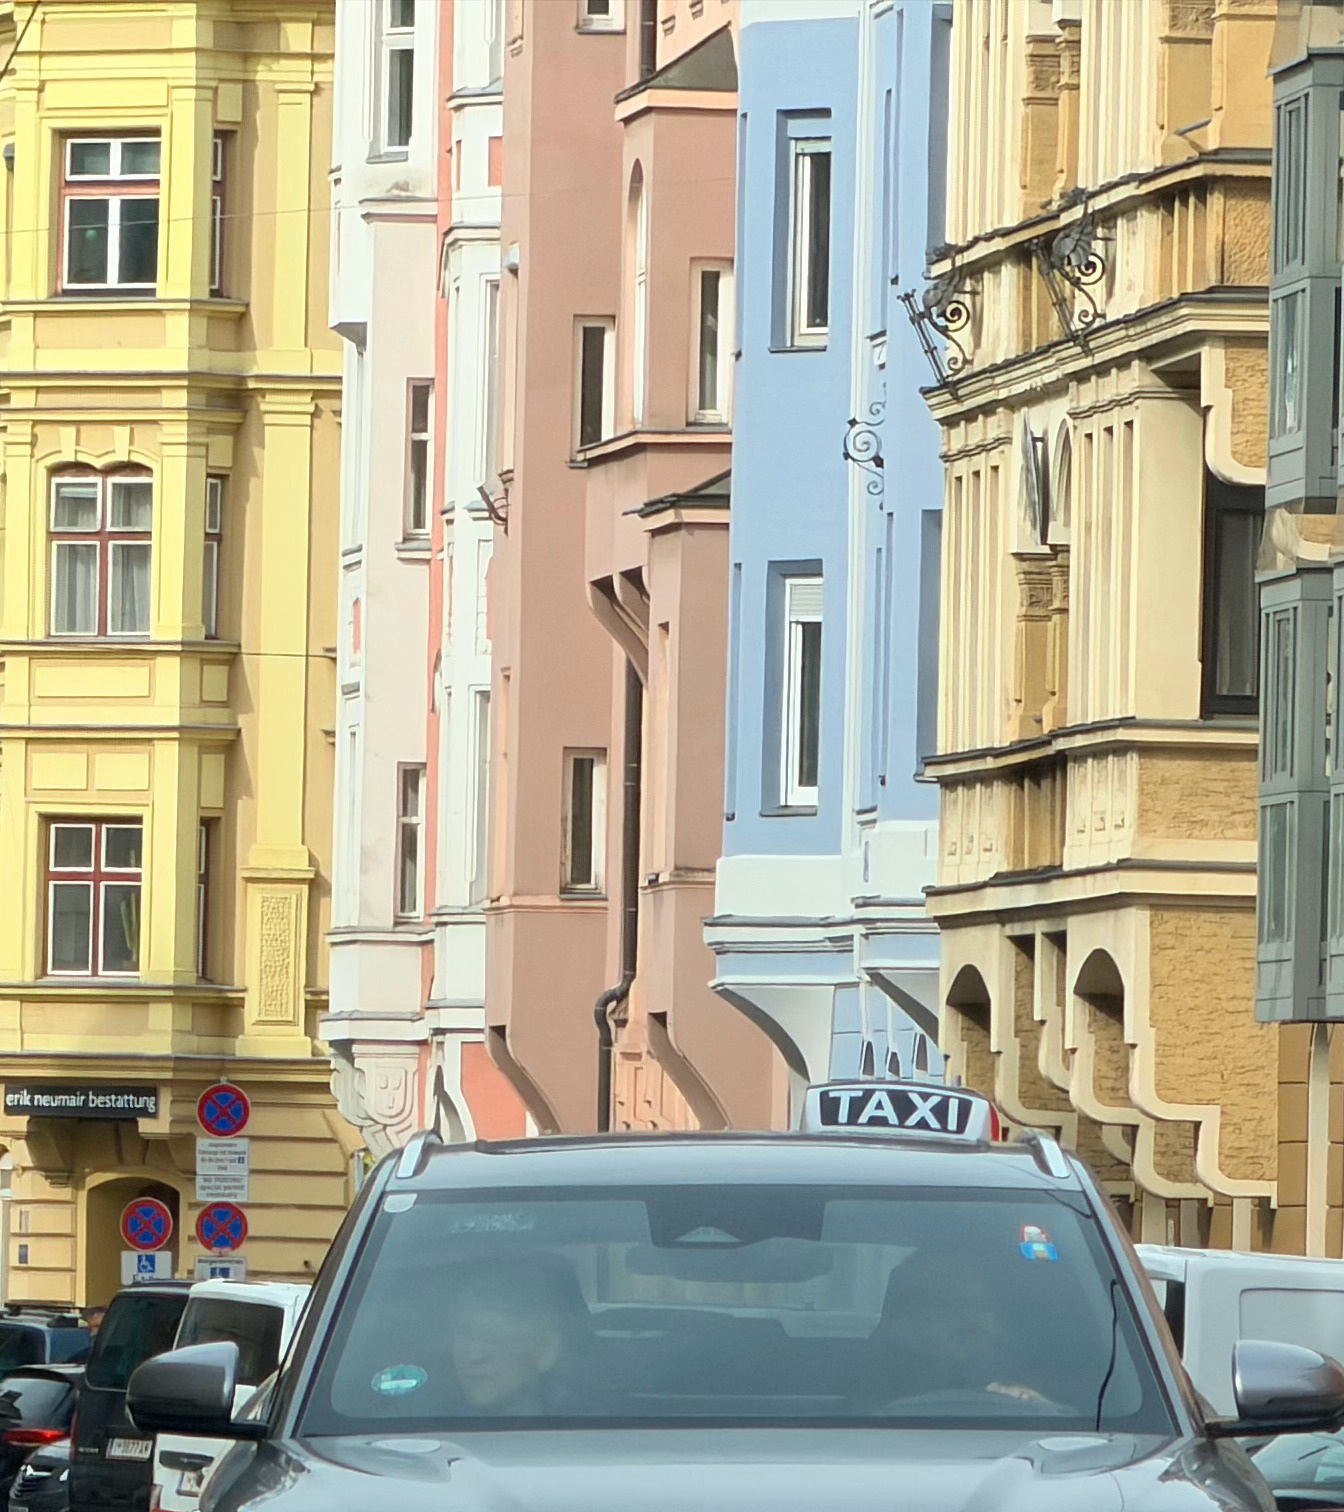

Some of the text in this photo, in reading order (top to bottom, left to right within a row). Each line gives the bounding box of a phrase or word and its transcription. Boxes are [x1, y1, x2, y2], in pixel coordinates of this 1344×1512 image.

[6, 1088, 156, 1112] erik neumair bestattung
[829, 1091, 959, 1131] TAXI
